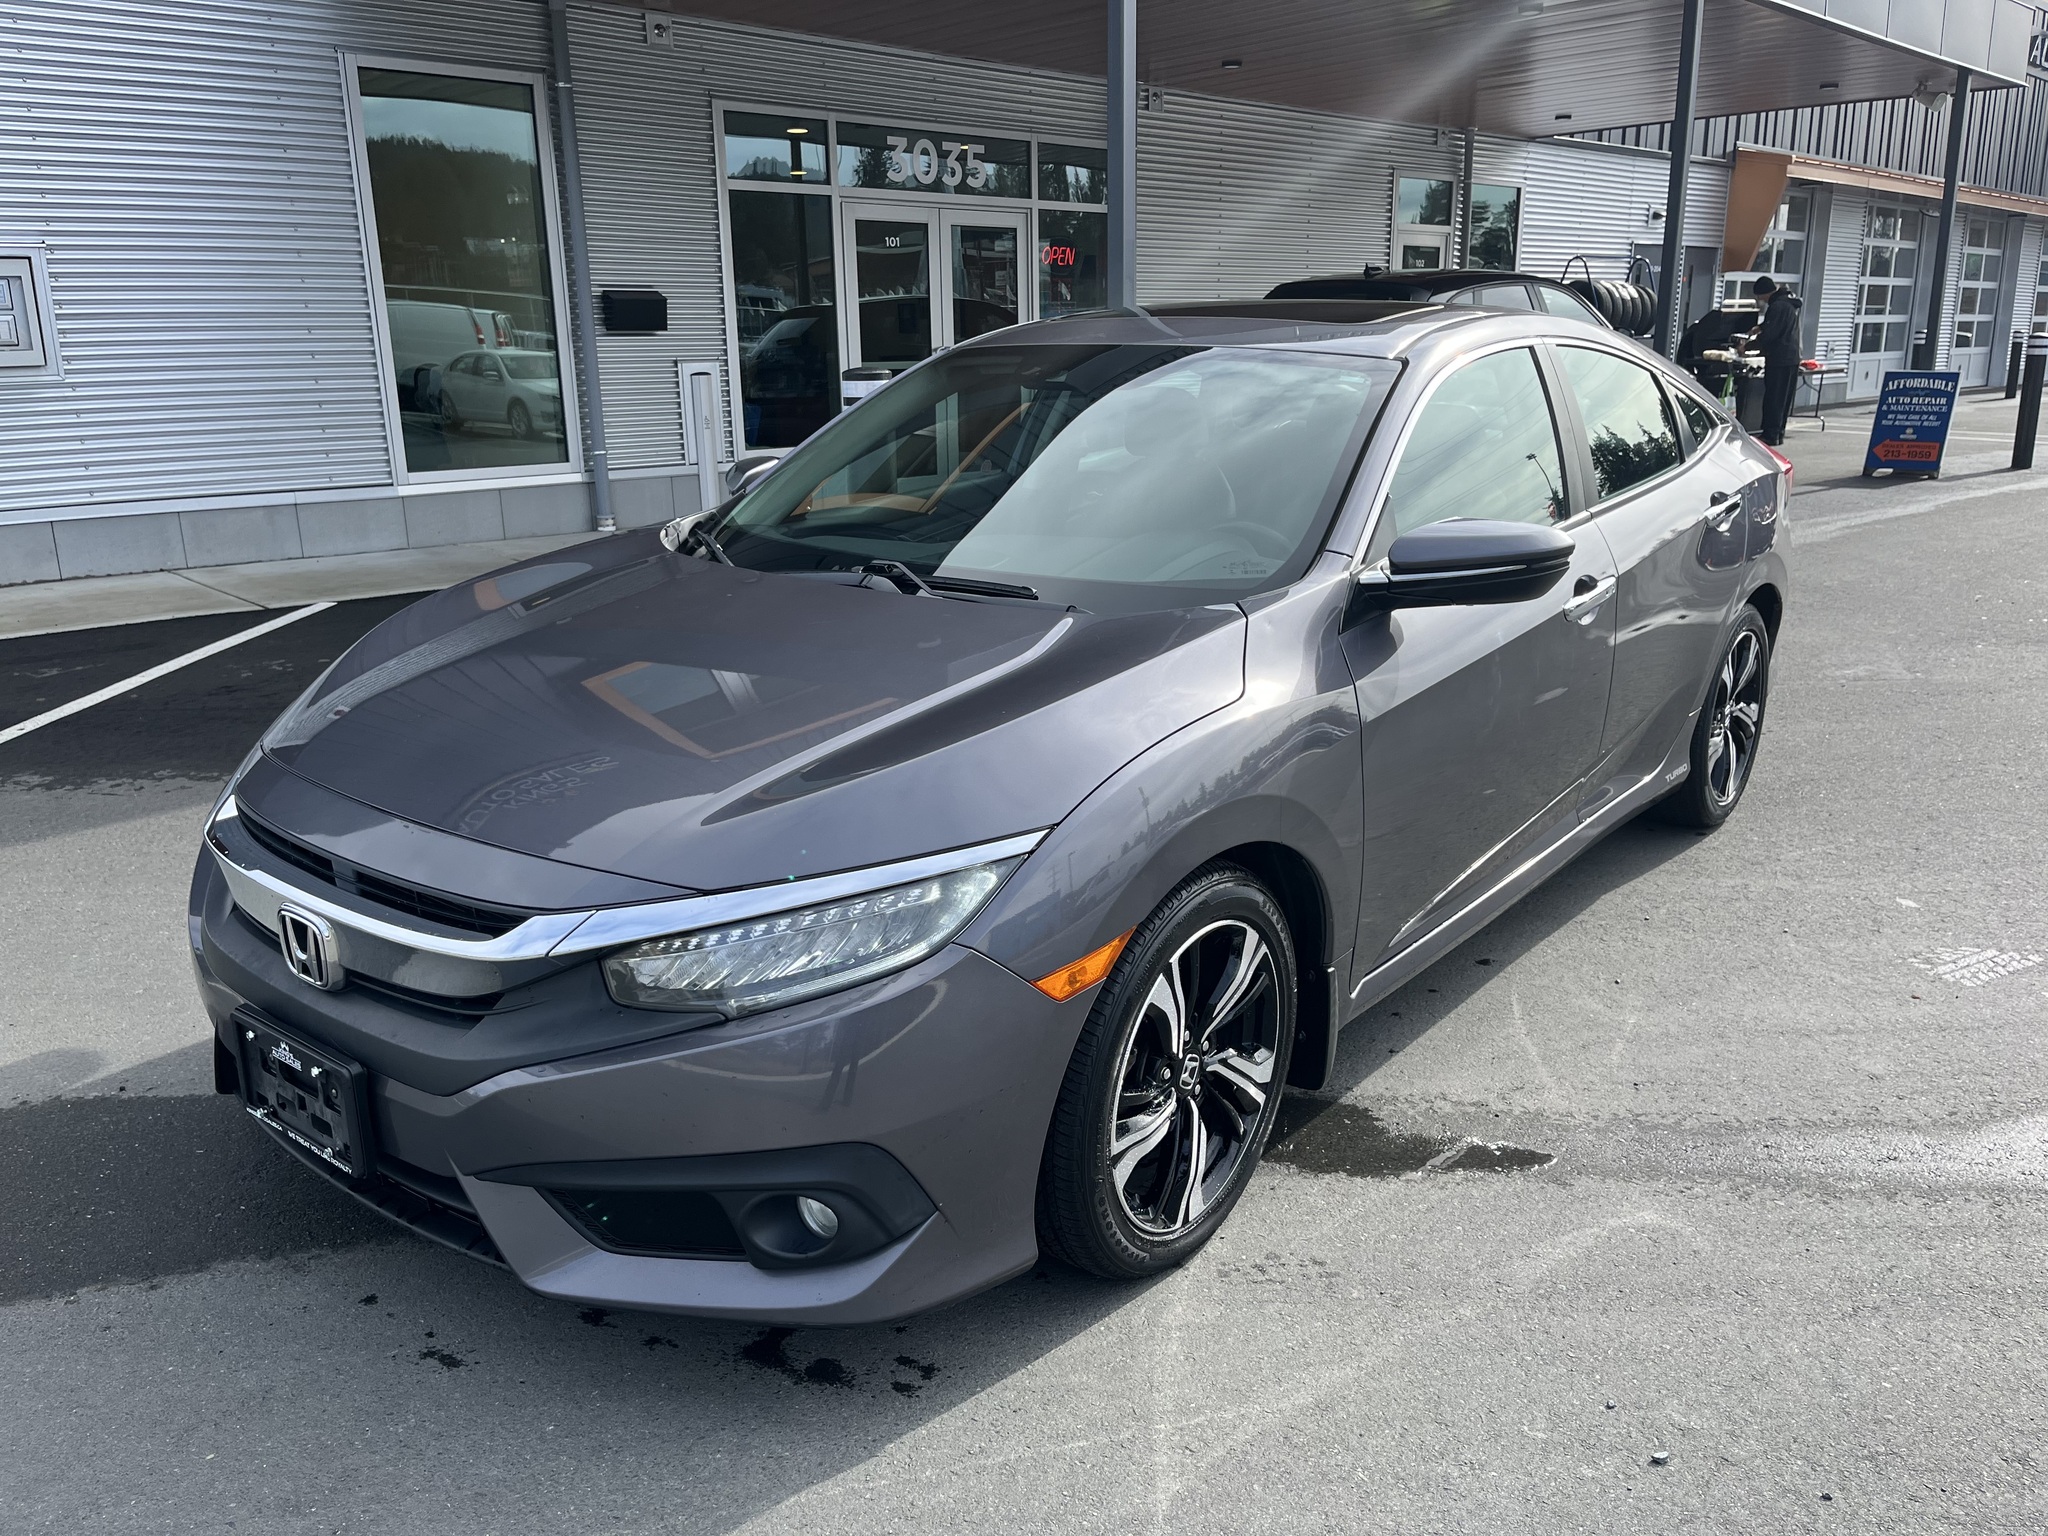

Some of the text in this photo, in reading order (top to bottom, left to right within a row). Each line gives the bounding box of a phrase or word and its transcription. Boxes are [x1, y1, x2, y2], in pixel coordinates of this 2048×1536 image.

[886, 135, 987, 188] 3035
[885, 236, 900, 247] 101
[1041, 246, 1076, 266] OPEN
[1415, 259, 1425, 268] 102
[1885, 378, 1955, 393] AFFORDABLE
[1886, 396, 1948, 405] AUTO REPAIR
[1889, 404, 1948, 413] MAINTENANCE
[1883, 449, 1932, 460] 213-1959
[1665, 763, 1688, 782] TURBO
[1097, 1195, 1148, 1264] Firestone
